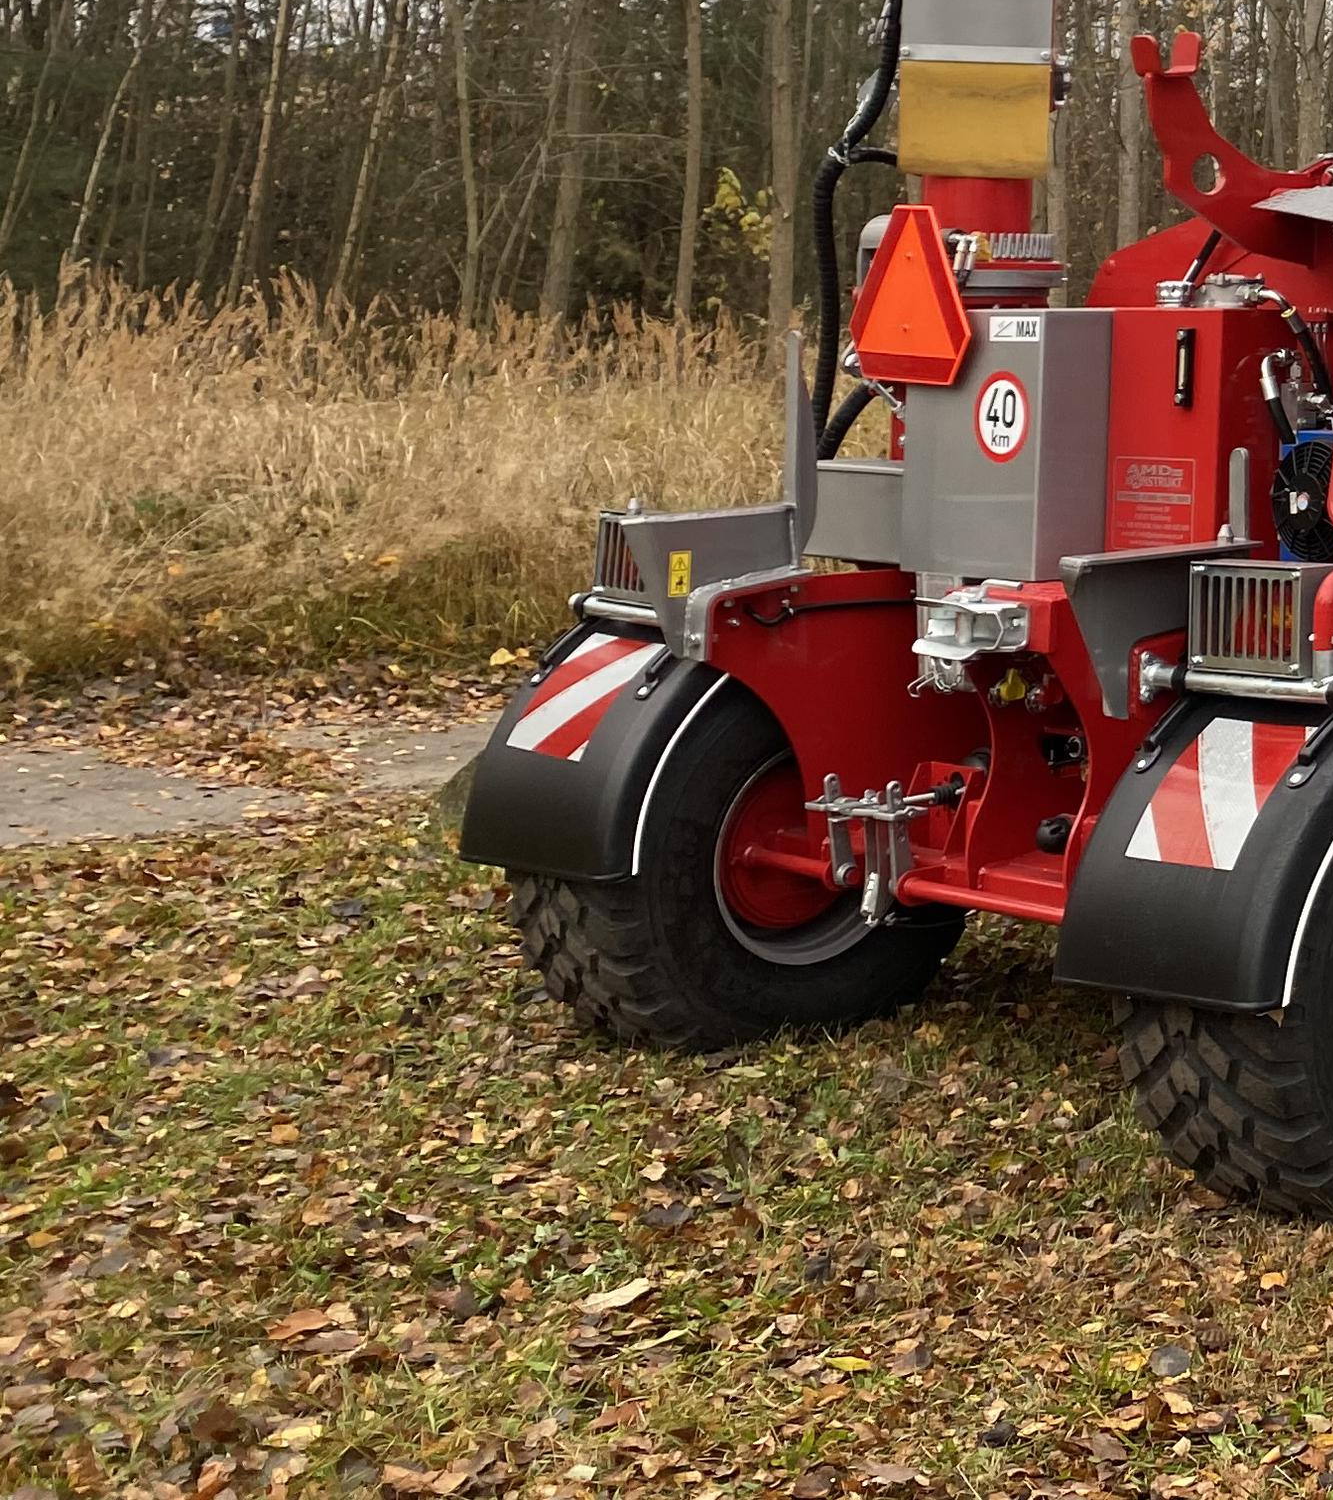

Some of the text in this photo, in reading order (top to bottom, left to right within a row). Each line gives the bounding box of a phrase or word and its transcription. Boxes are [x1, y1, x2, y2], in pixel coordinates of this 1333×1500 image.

[1015, 320, 1037, 338] MAX
[986, 387, 1016, 429] 40
[991, 429, 1010, 448] km
